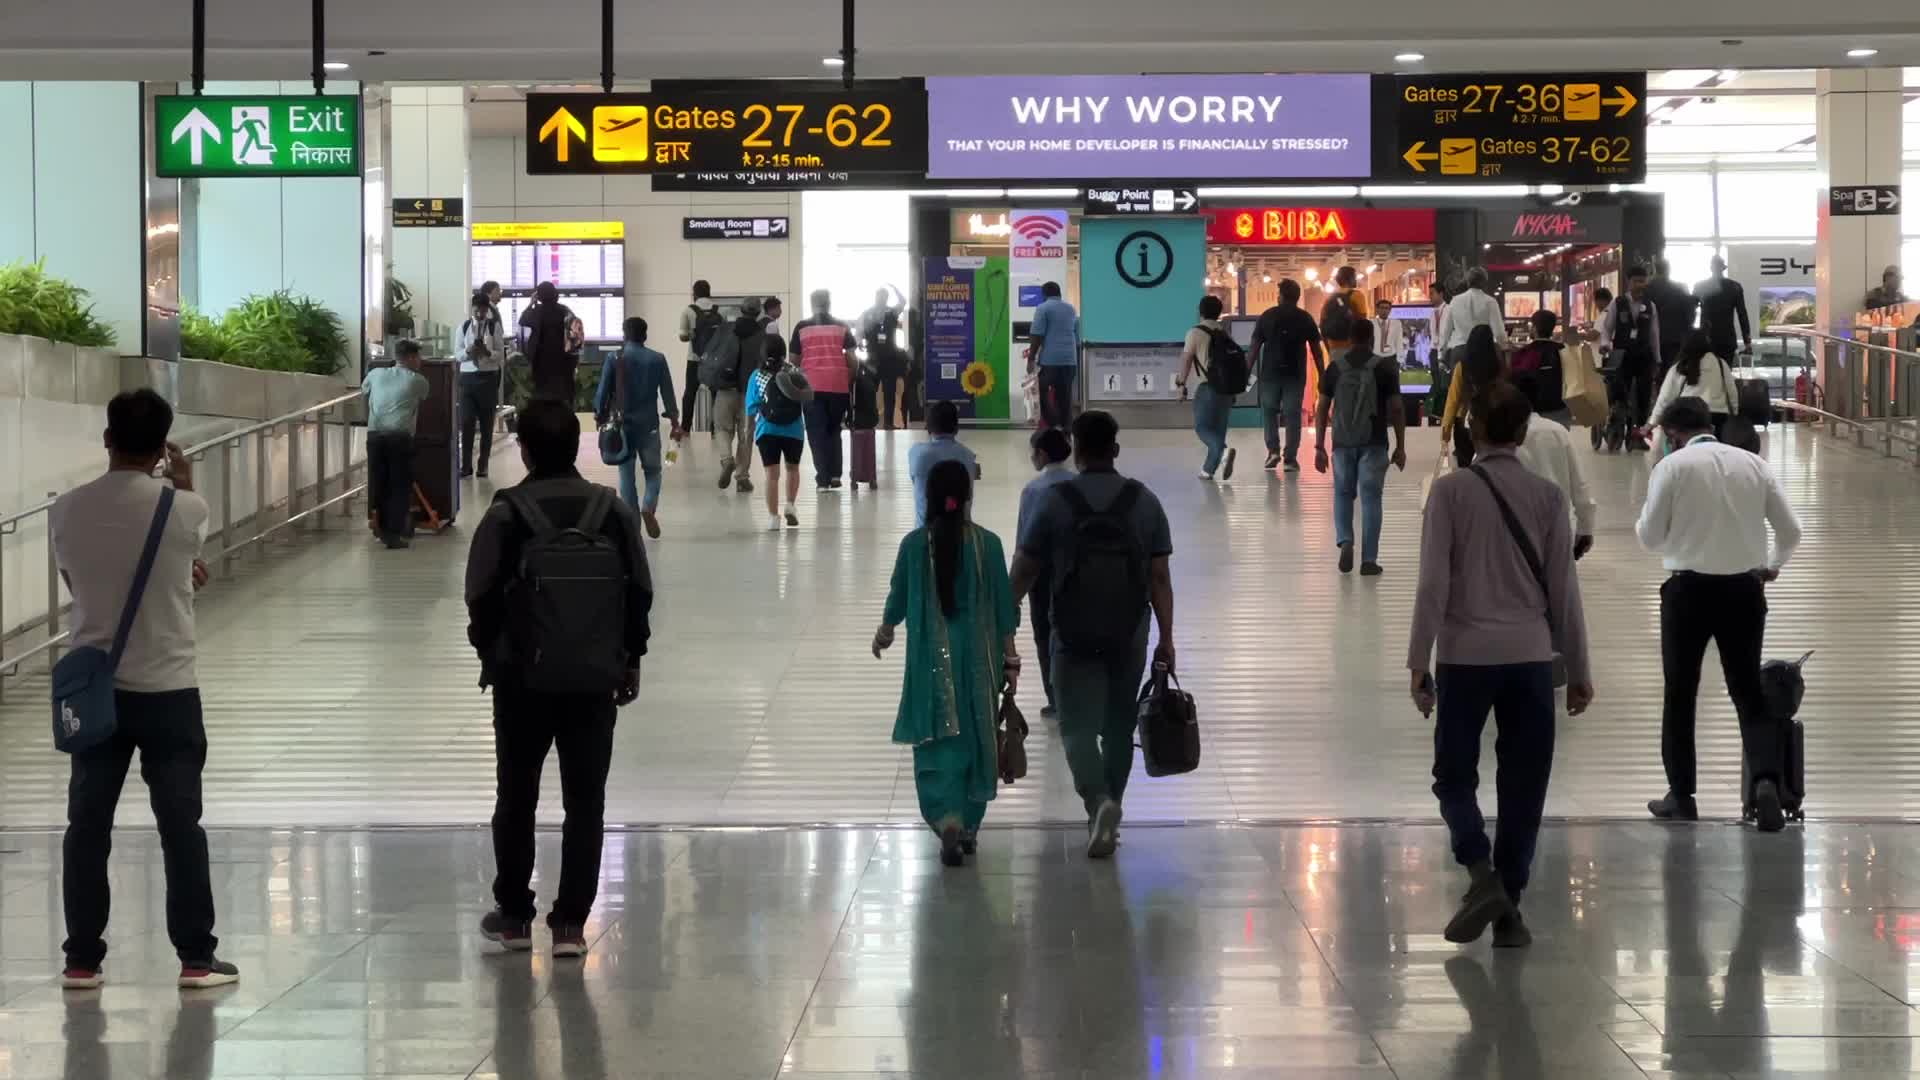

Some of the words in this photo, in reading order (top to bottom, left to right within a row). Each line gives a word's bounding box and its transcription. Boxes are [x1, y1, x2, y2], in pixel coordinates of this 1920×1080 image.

[1011, 96, 1110, 124] WHY
[1125, 95, 1283, 123] WORRY
[1404, 86, 1458, 102] Gates
[1462, 84, 1561, 113] 27-36
[289, 105, 345, 132] Exit
[654, 105, 736, 129] Gates
[741, 104, 893, 147] 27-62
[289, 141, 352, 165] निकास
[654, 142, 692, 164] द्वार
[947, 139, 984, 151] THAT
[986, 139, 1027, 151] YOUR
[1030, 139, 1073, 151] HOME
[1076, 139, 1159, 151] DEVELOPER
[1163, 138, 1176, 150] IS
[1179, 138, 1269, 150] FINANCIALLY
[1272, 137, 1350, 150] STRESSED?
[1481, 137, 1537, 154] Gates
[1541, 137, 1632, 163] 37-62
[755, 154, 791, 168] 2-15
[794, 153, 825, 168] min.
[1088, 189, 1120, 202] Buggy
[1122, 189, 1150, 200] Point
[1832, 190, 1854, 202] Spa
[689, 219, 725, 230] Smoking
[727, 219, 752, 228] Room
[1263, 211, 1346, 240] BIBA
[1511, 214, 1577, 237] NYKAA
